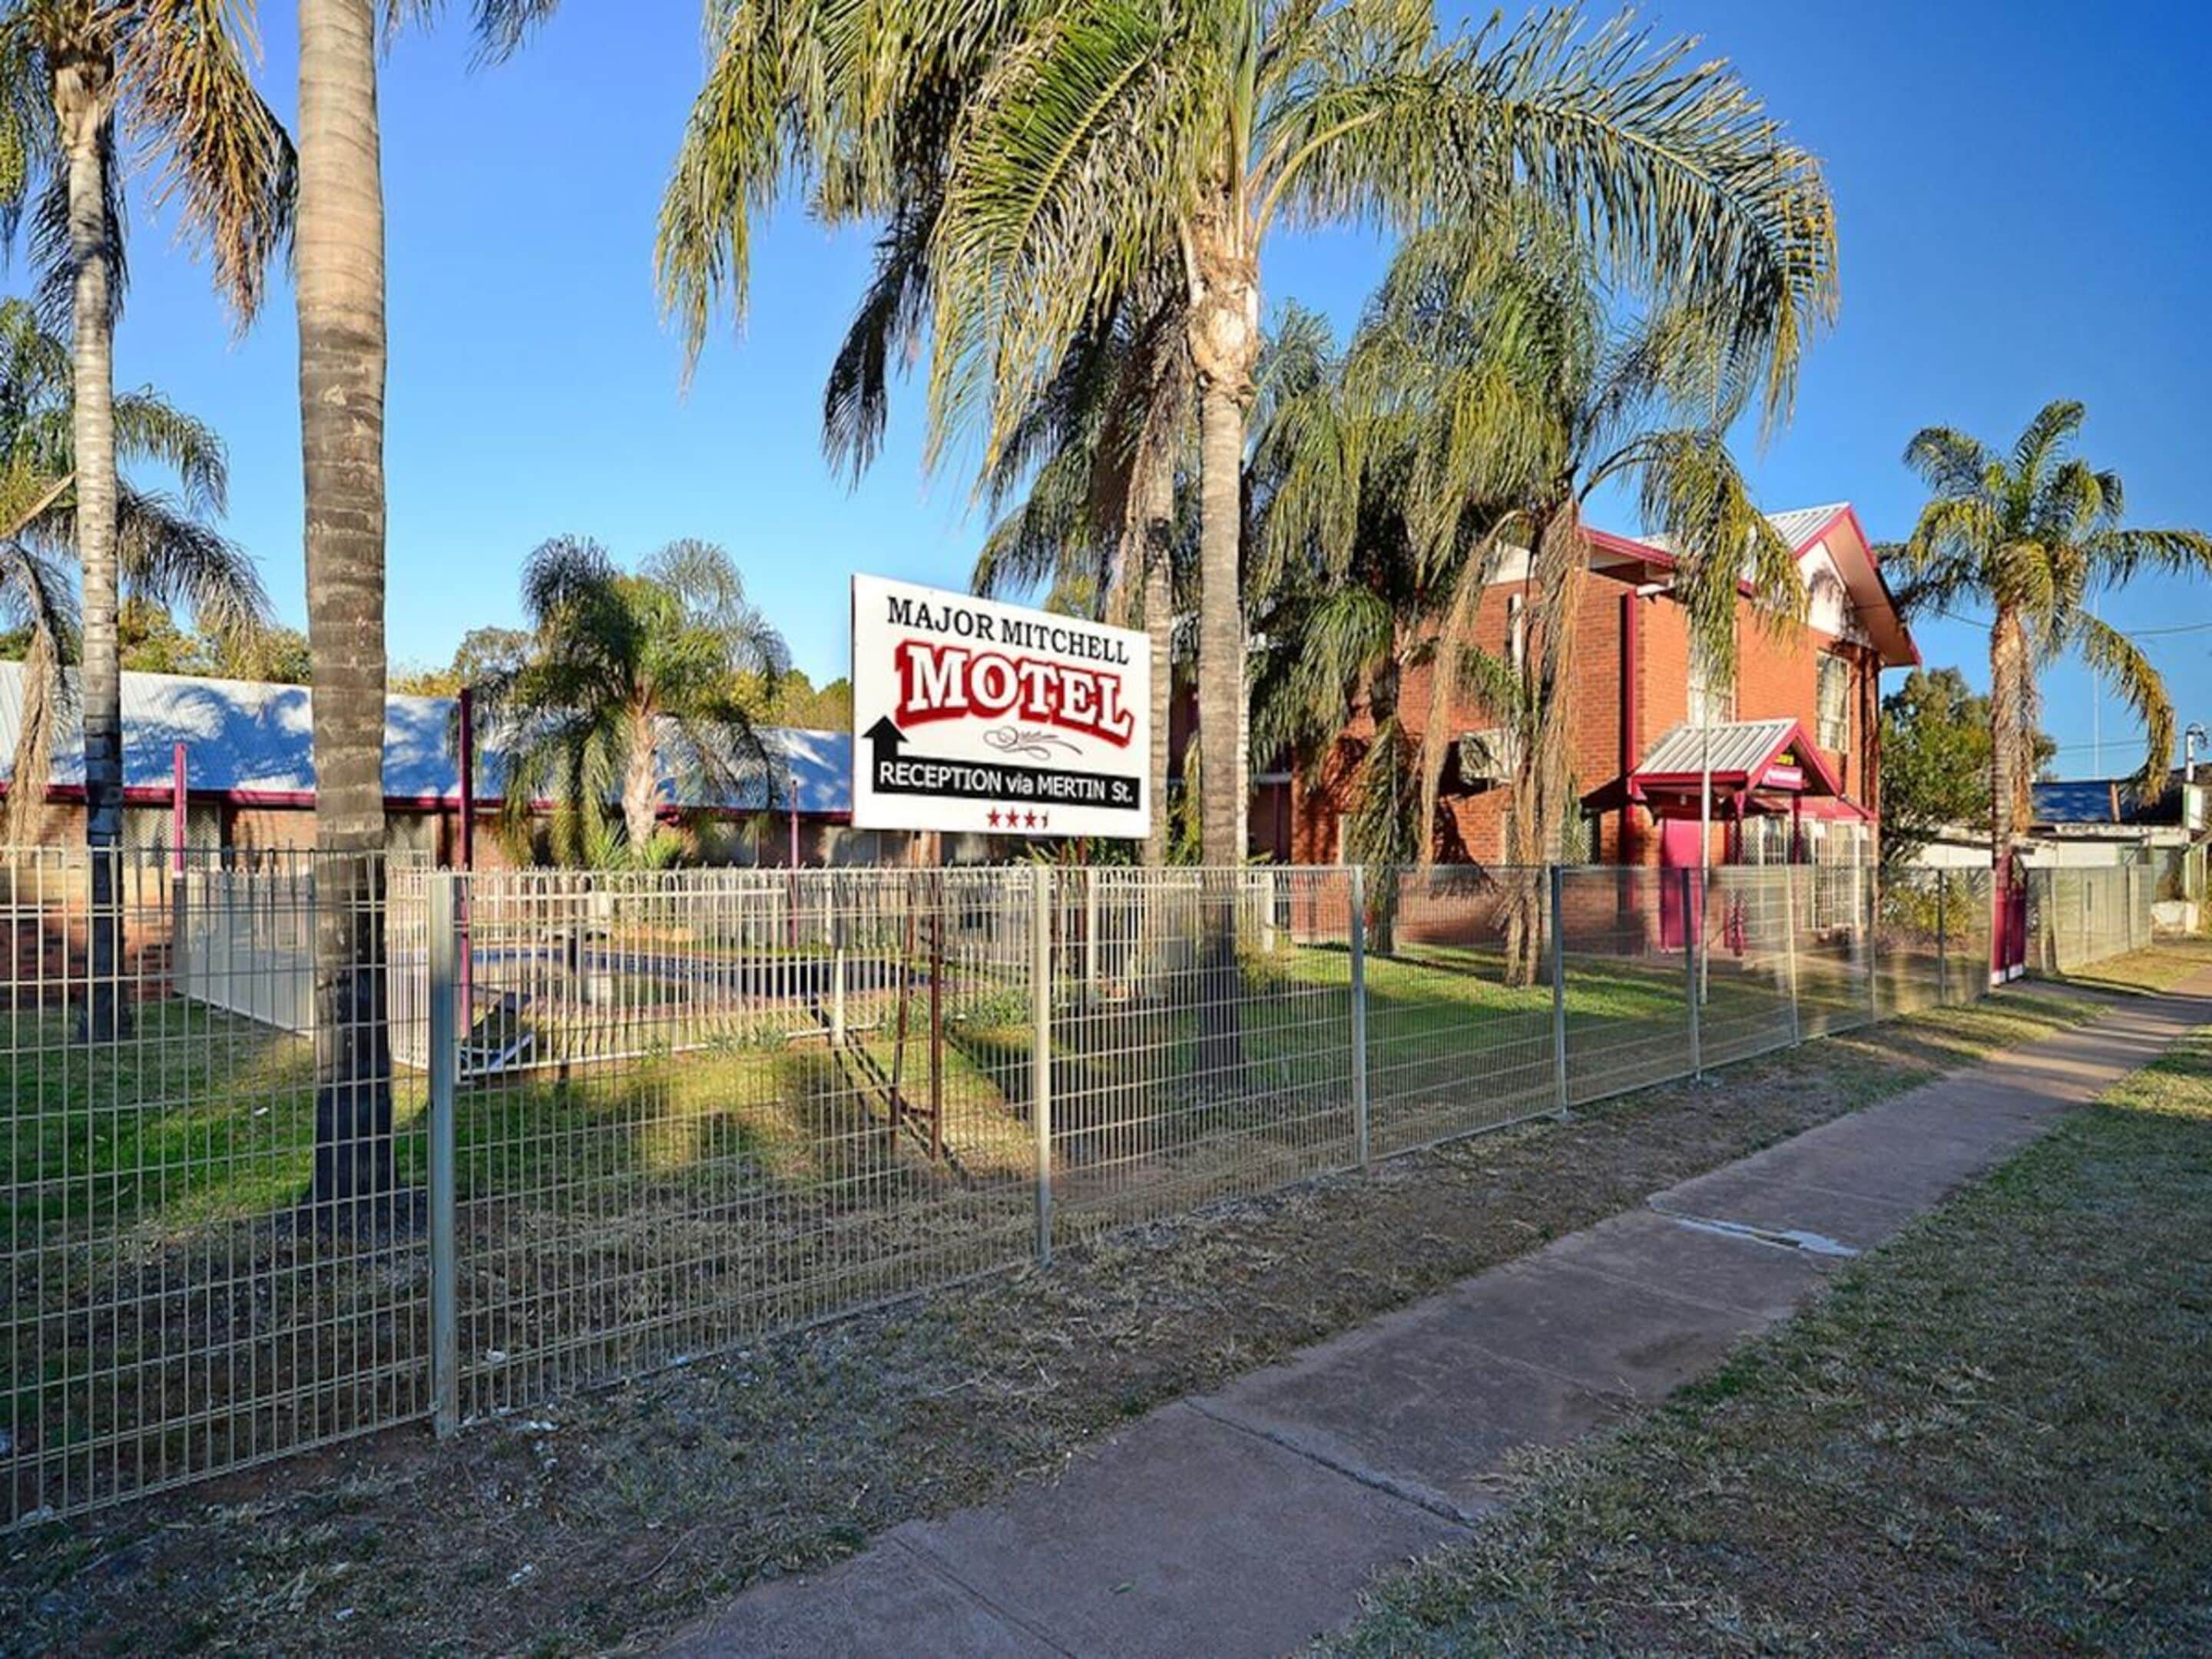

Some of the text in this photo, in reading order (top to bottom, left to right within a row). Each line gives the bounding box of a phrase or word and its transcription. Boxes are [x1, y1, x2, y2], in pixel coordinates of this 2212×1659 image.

[887, 596, 1130, 665] MAJOR MITCHELL
[896, 639, 1134, 748] MOTEL
[879, 761, 1134, 803] RECEPTION via MERTIN St.
